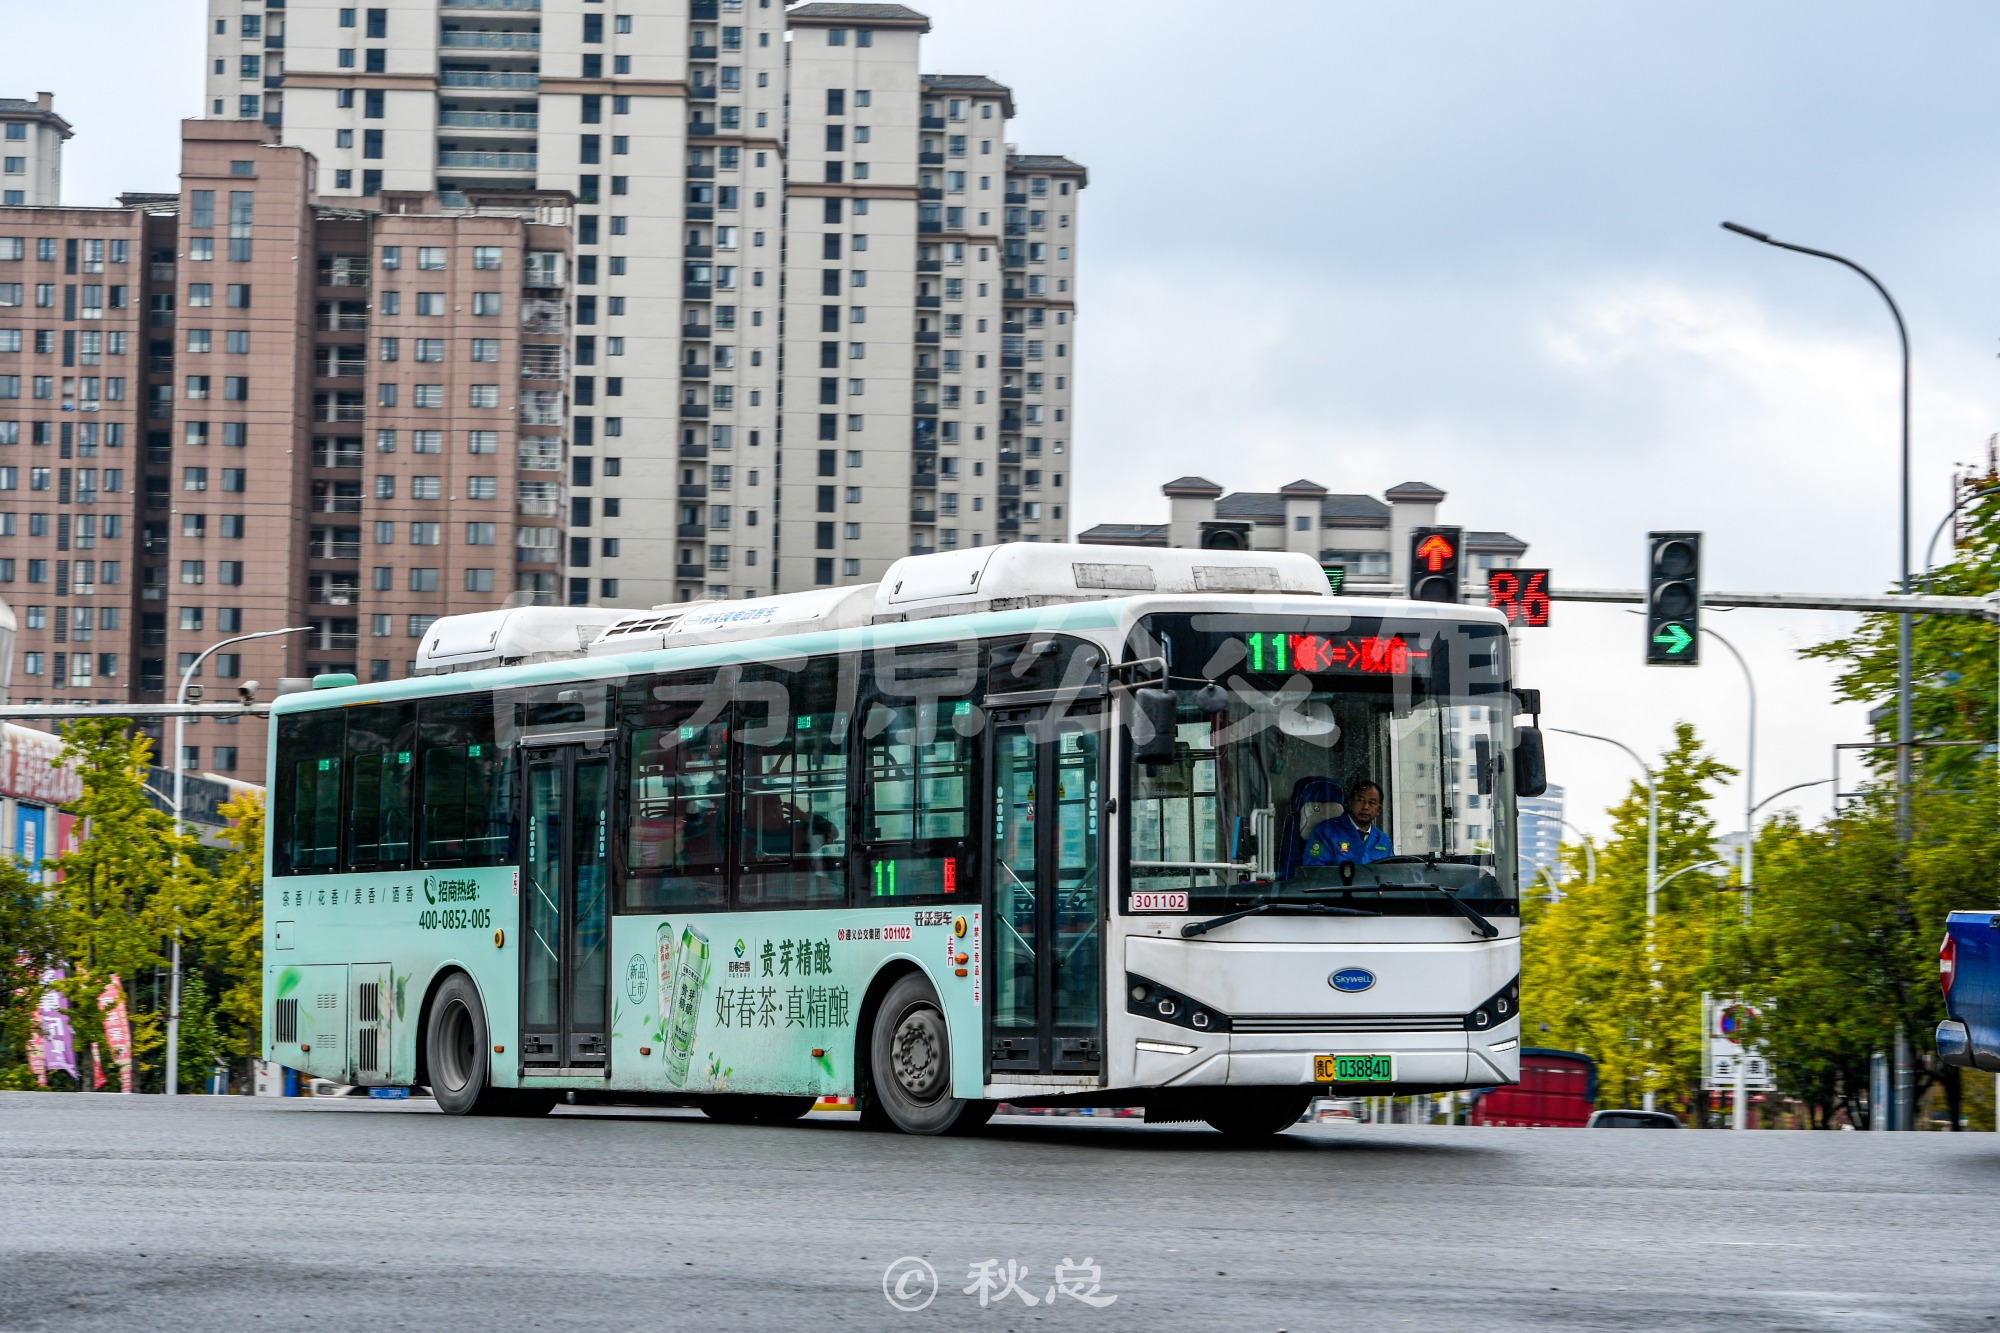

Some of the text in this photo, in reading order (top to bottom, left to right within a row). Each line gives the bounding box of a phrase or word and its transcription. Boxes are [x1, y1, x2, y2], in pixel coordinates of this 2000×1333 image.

[1249, 632, 1287, 671] 11
[875, 860, 895, 896] 11
[1135, 895, 1184, 908] 301102
[418, 908, 491, 930] 400-0852-005
[845, 926, 911, 941] 遵义公交集团 301102
[760, 938, 832, 978] 贵芽精酿
[629, 963, 645, 980] 新品
[628, 980, 645, 997] 上市
